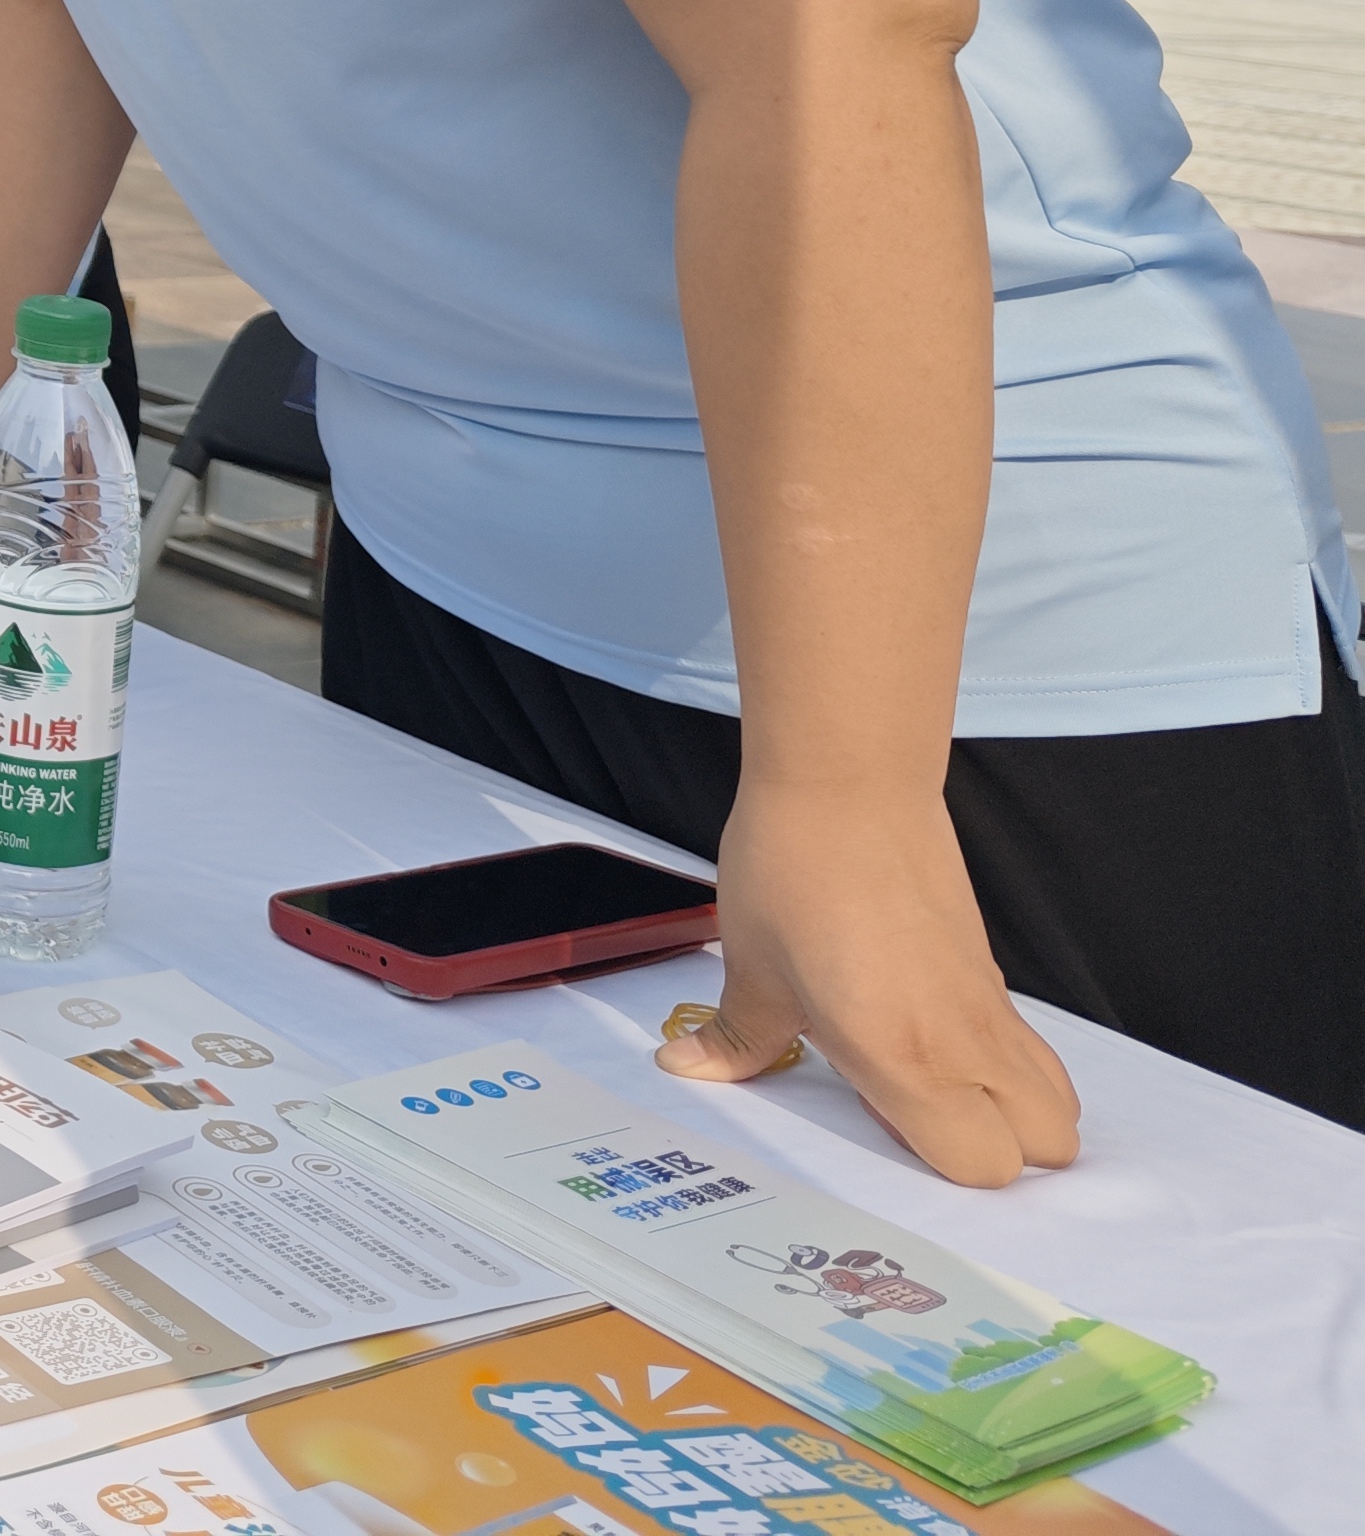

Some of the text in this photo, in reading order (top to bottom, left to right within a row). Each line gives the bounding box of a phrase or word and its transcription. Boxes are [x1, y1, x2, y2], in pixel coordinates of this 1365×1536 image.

[39, 768, 78, 780] WATER
[571, 1146, 624, 1166] 走出
[557, 1150, 715, 1202] 用械误区
[612, 1176, 756, 1222] 守护你我健康
[46, 1502, 100, 1536] 源自河
